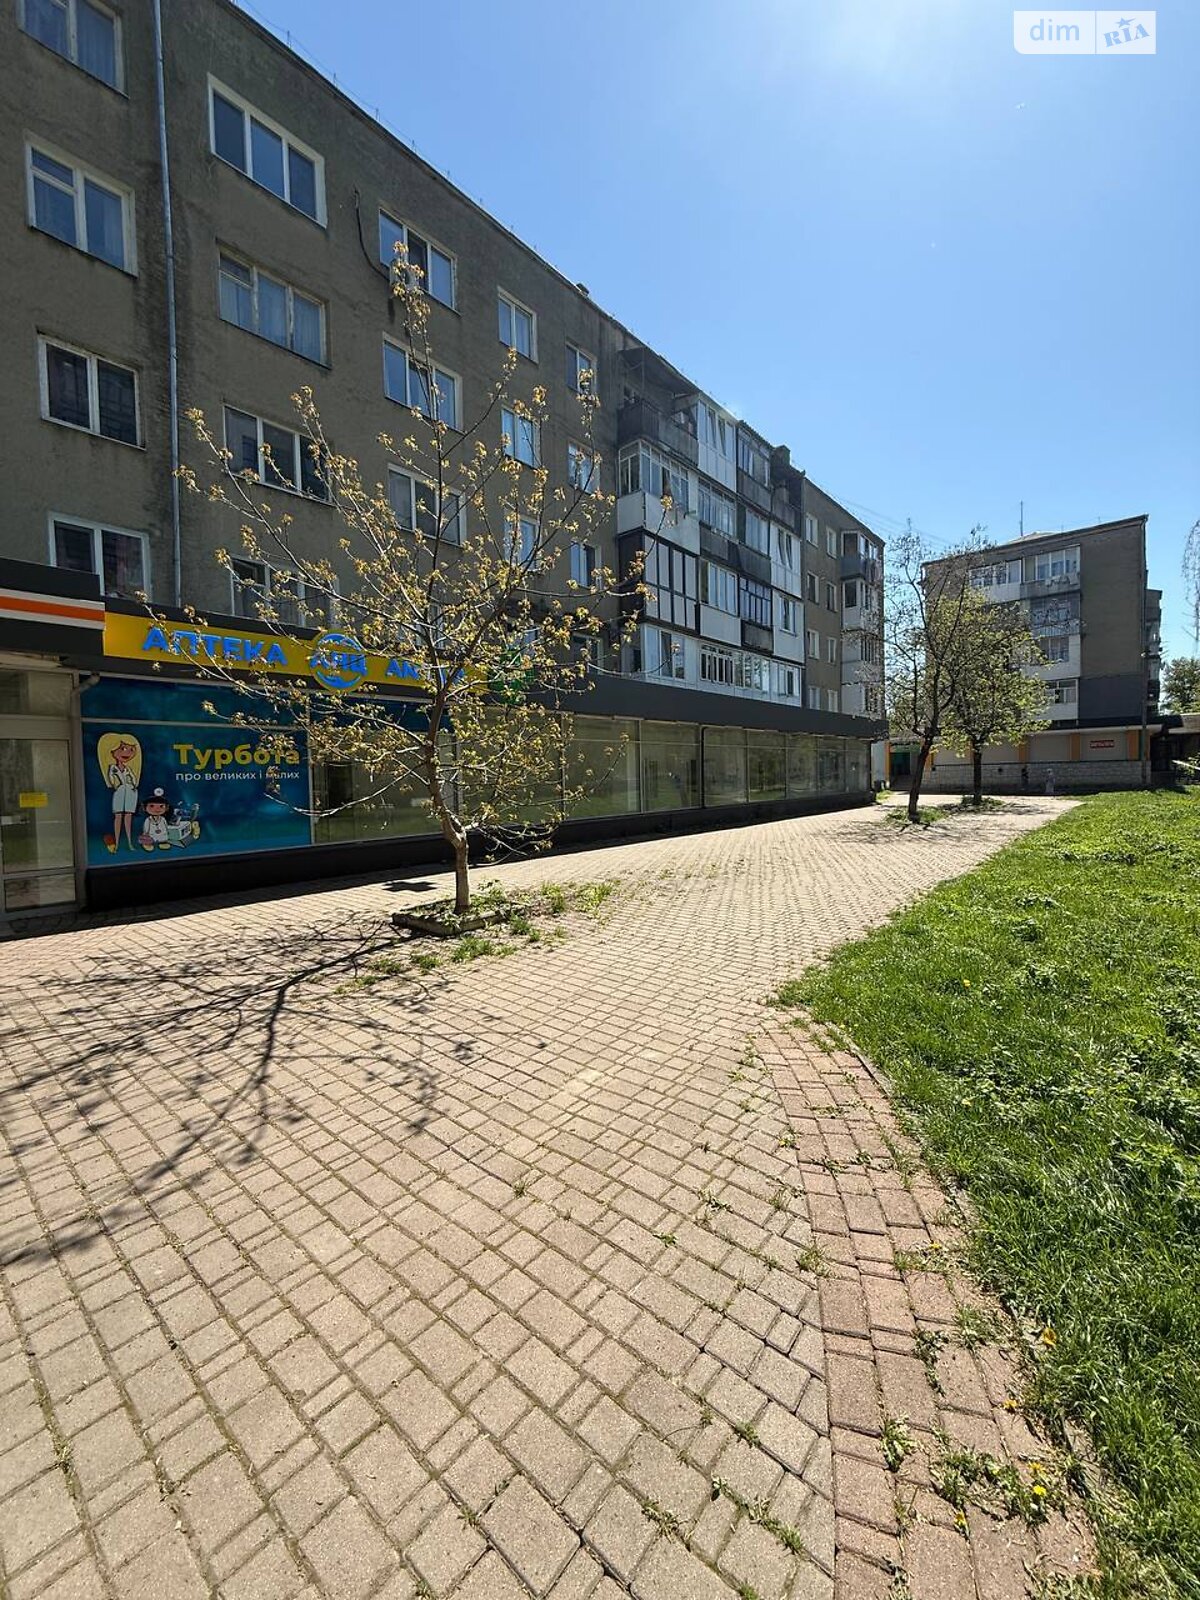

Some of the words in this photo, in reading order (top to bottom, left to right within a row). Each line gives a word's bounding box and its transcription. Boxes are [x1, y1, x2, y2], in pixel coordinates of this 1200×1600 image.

[142, 626, 288, 666] АПТЕКА
[175, 772, 201, 783] про
[204, 771, 257, 781] великих
